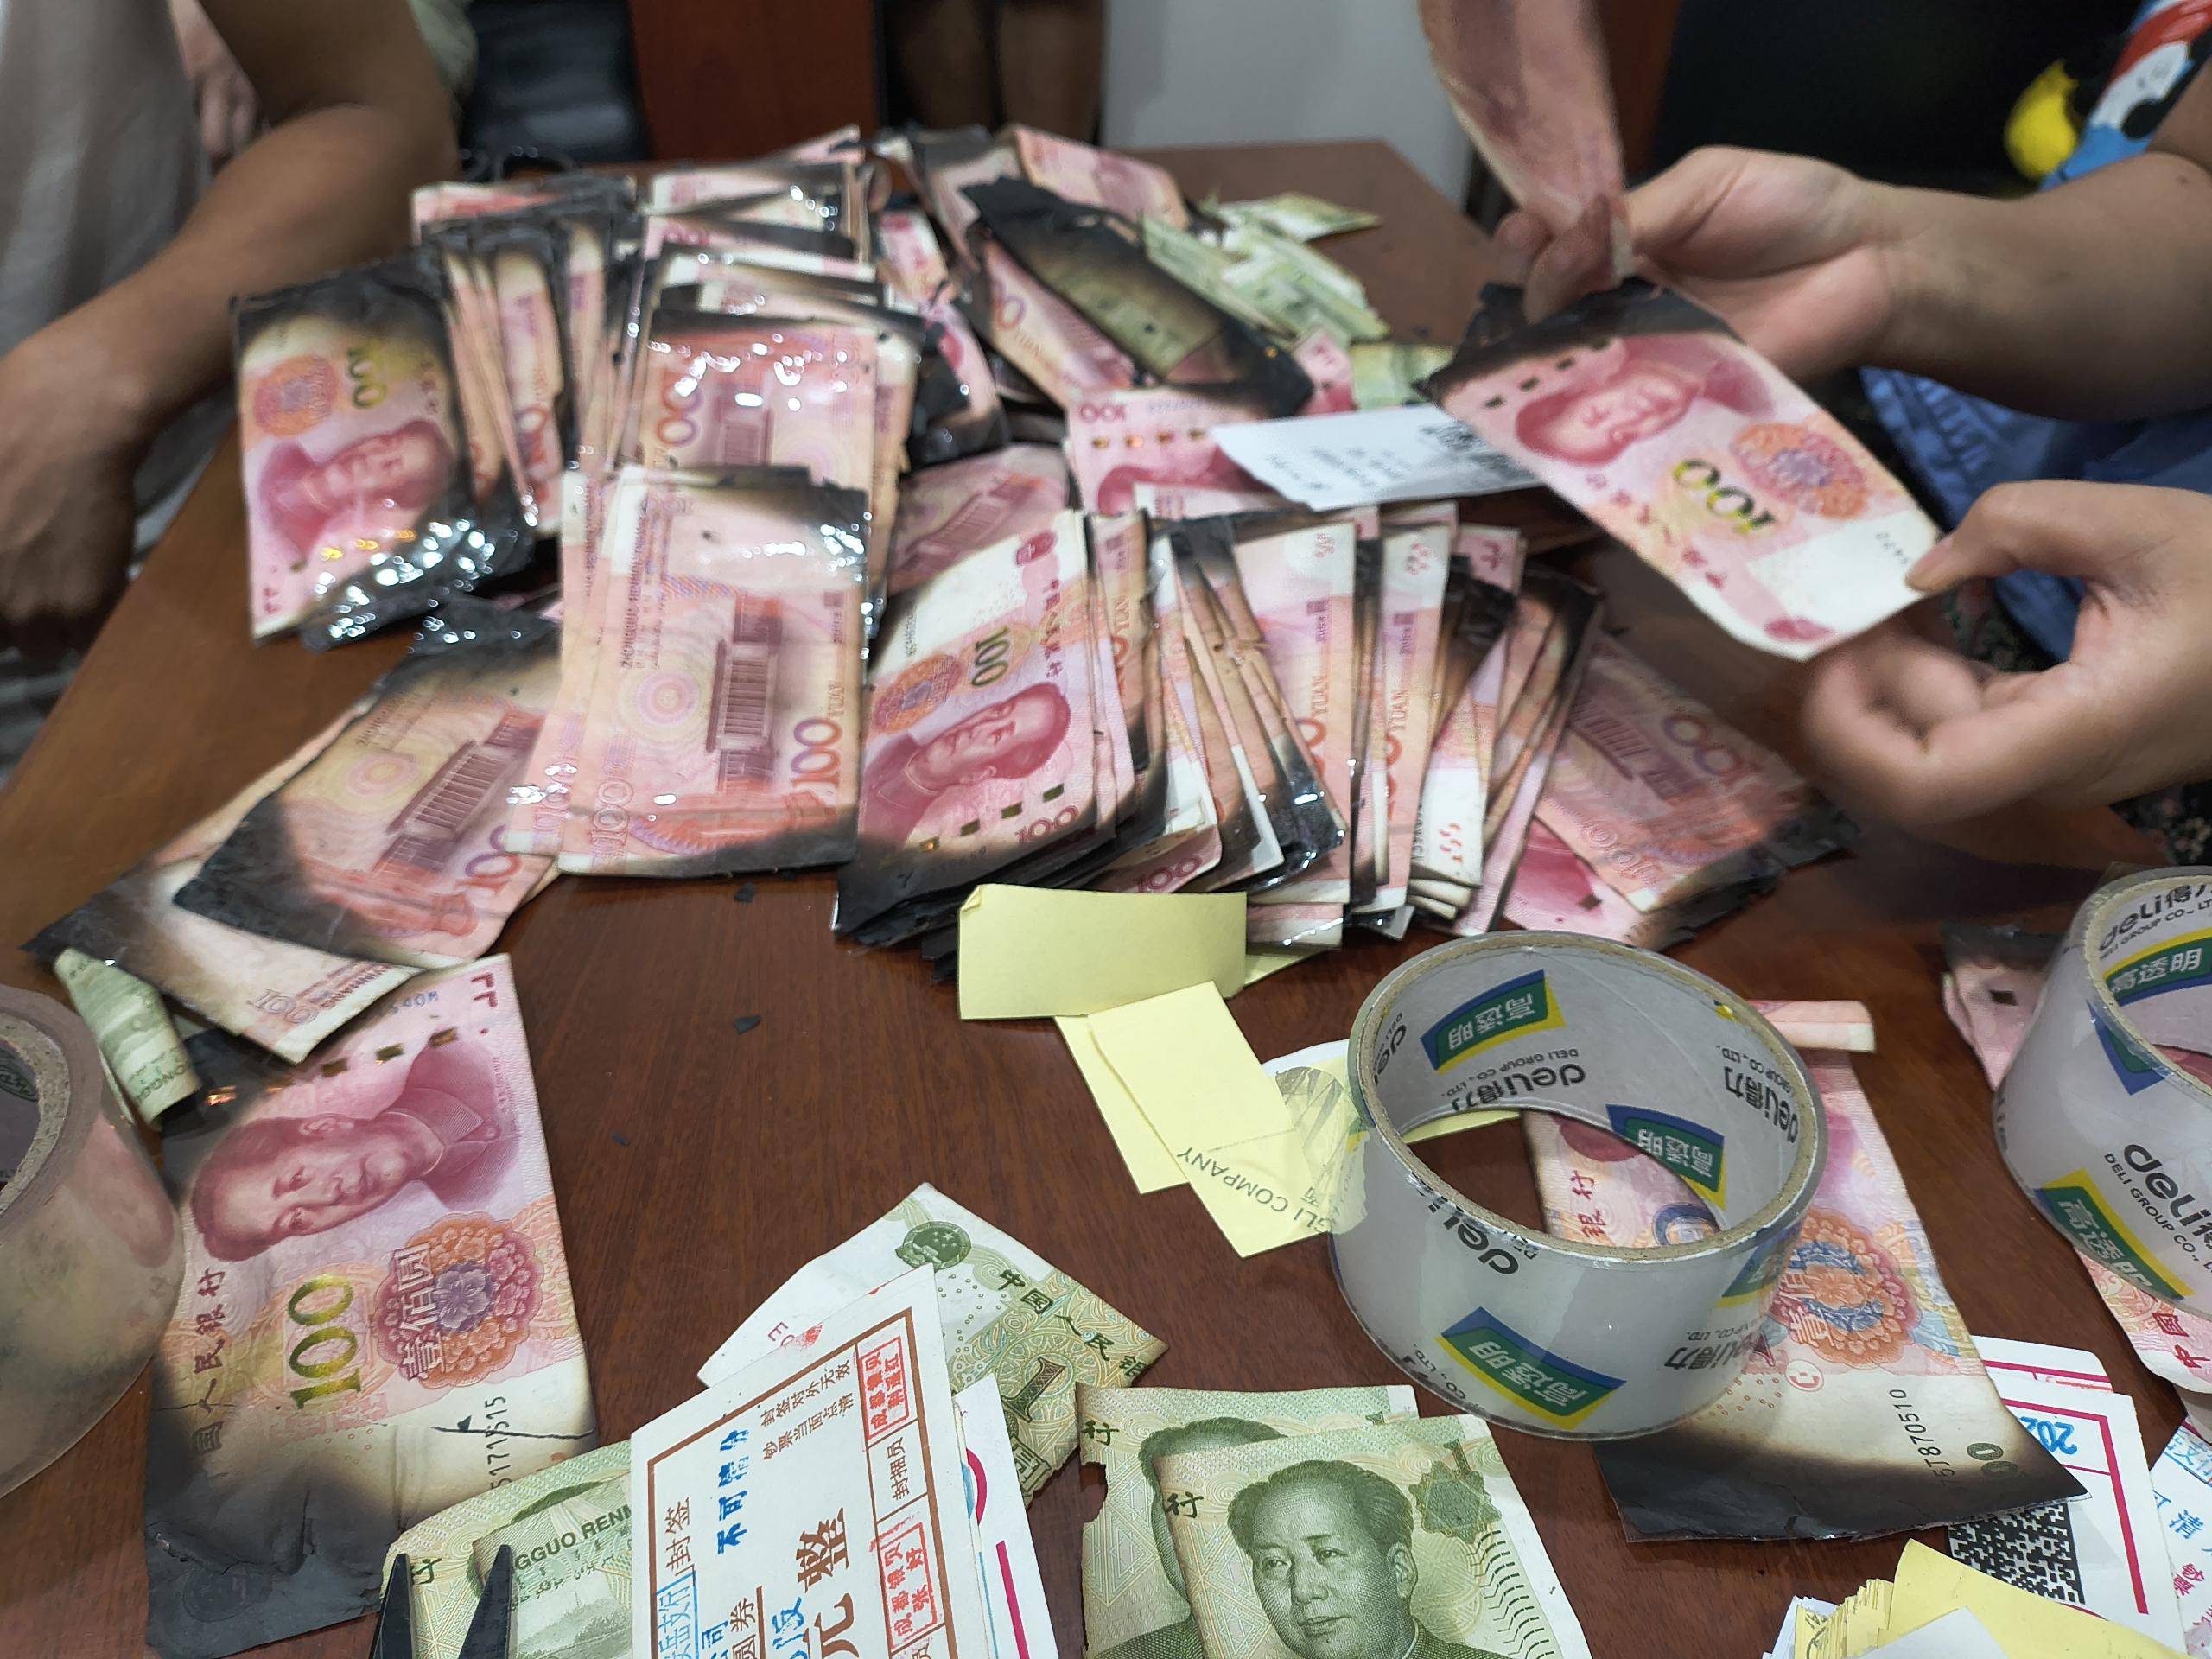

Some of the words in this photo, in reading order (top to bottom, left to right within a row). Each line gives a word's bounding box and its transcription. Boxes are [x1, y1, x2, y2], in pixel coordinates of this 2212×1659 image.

[969, 626, 1011, 689] 100
[791, 718, 843, 790] 100
[1017, 804, 1080, 844] 100
[1447, 991, 1536, 1050] 高透明
[1493, 1052, 1544, 1073] GROUP
[1547, 1047, 1580, 1061] DELI
[1176, 1146, 1290, 1214] COMPANY
[1637, 1127, 1714, 1179] 高透明
[2104, 1153, 2133, 1185] DELI
[2130, 1187, 2175, 1231] GROUP
[288, 1273, 362, 1410] 100
[2151, 1311, 2211, 1370] 中国
[760, 1358, 852, 1429] 封签对外无效
[1468, 1340, 1588, 1408] 高透明
[762, 1392, 856, 1462] 钞票当面点清
[1080, 1420, 1121, 1446] 行
[892, 1435, 911, 1502] 封捆员
[664, 1496, 691, 1571] 封签
[1164, 1491, 1205, 1521] 行
